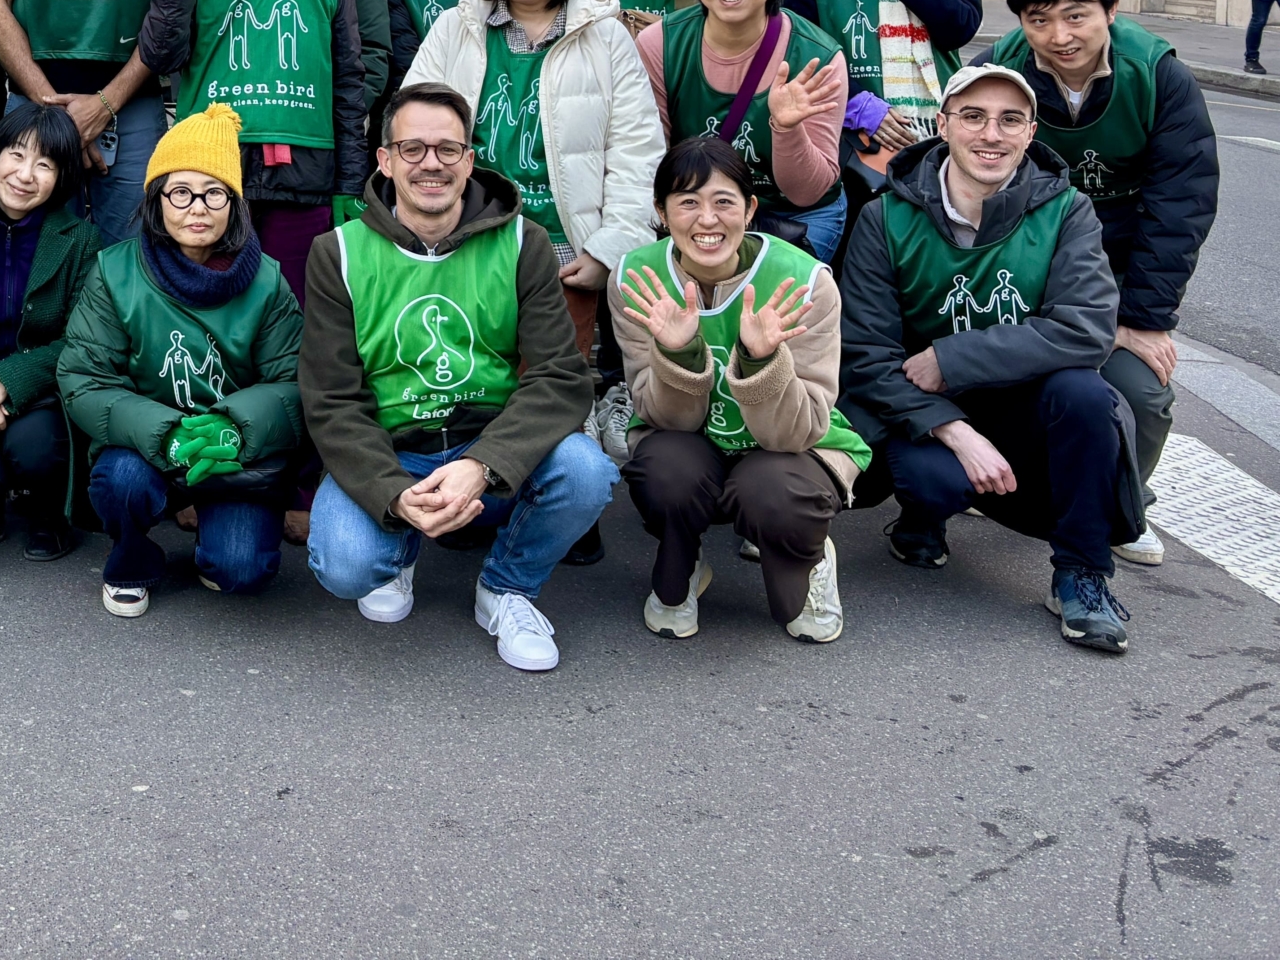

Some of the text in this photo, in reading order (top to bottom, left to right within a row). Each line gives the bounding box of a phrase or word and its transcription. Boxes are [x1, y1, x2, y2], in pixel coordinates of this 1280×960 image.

[235, 2, 243, 18] g
[282, 2, 291, 16] g
[207, 80, 315, 98] green bird
[264, 98, 289, 107] keep
[956, 290, 965, 304] g
[1001, 288, 1010, 301] g
[174, 350, 182, 364] g
[435, 351, 452, 382] g
[402, 387, 486, 403] green bird
[412, 403, 456, 420] Lafor
